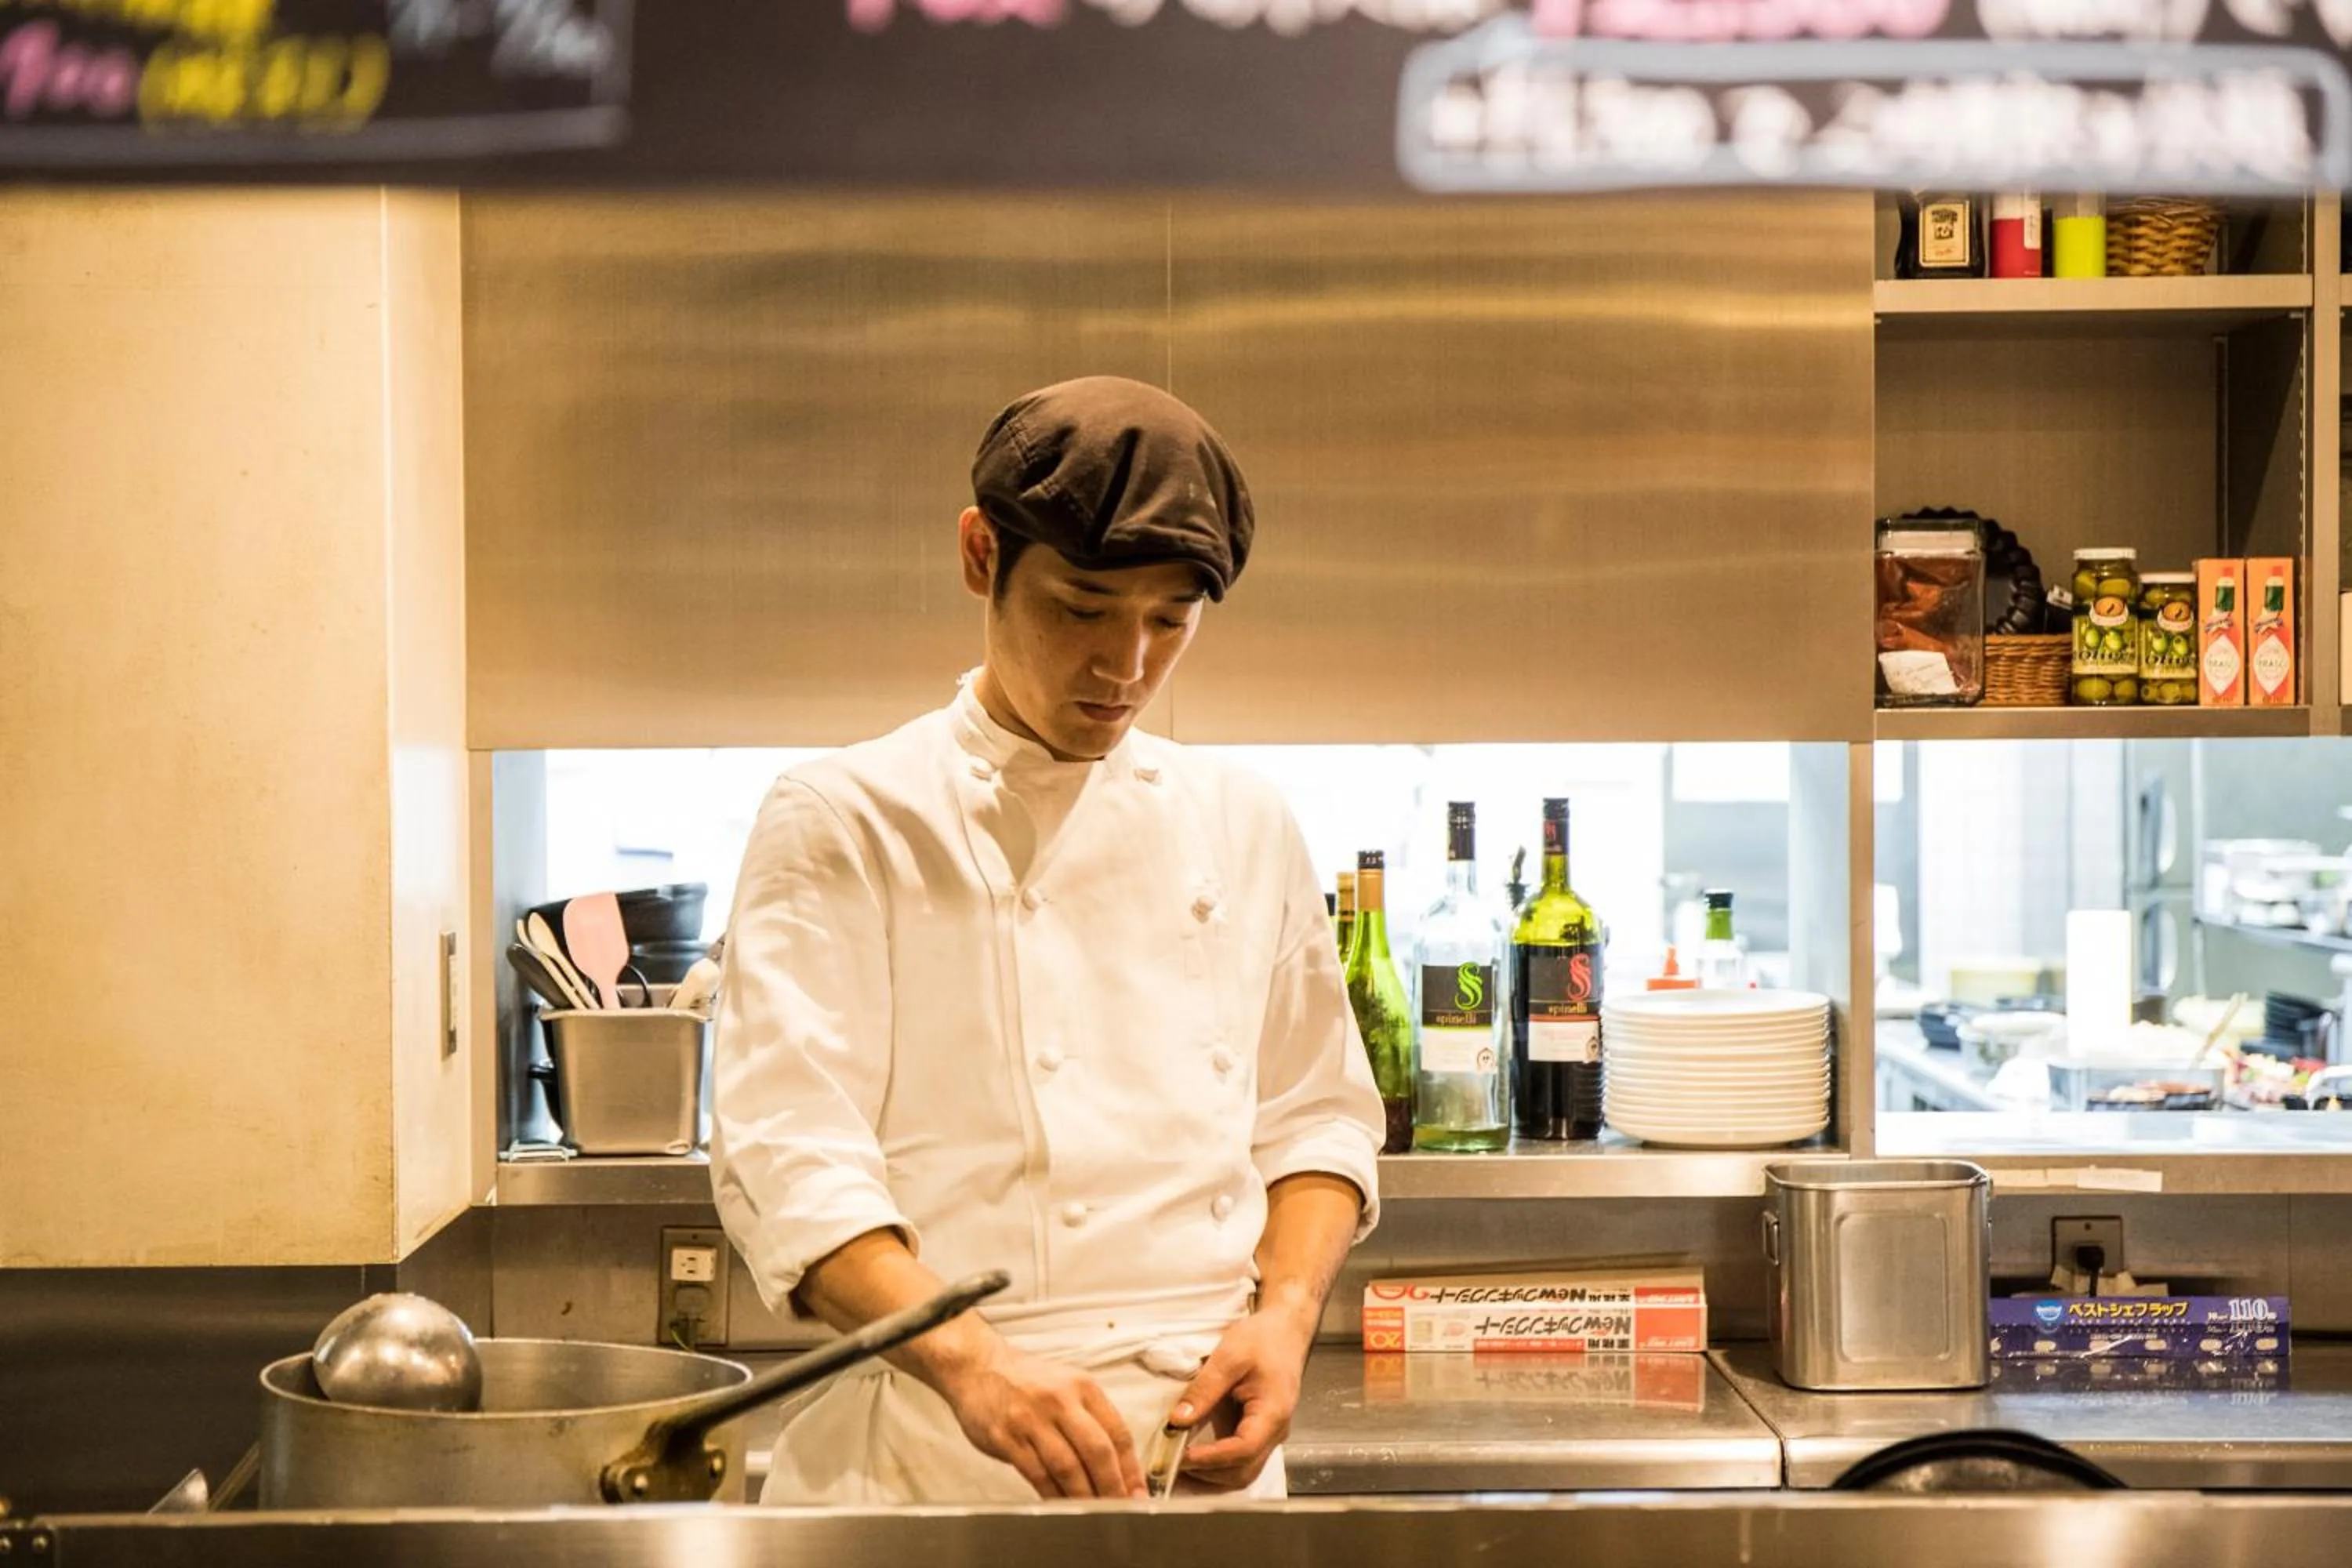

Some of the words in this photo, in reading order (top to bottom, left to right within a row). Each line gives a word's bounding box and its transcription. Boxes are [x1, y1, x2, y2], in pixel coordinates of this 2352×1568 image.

[1548, 1003, 1588, 1016] spinelli
[1436, 1012, 1477, 1026] spinelli
[2069, 1301, 2188, 1318] ベストシェフラップ
